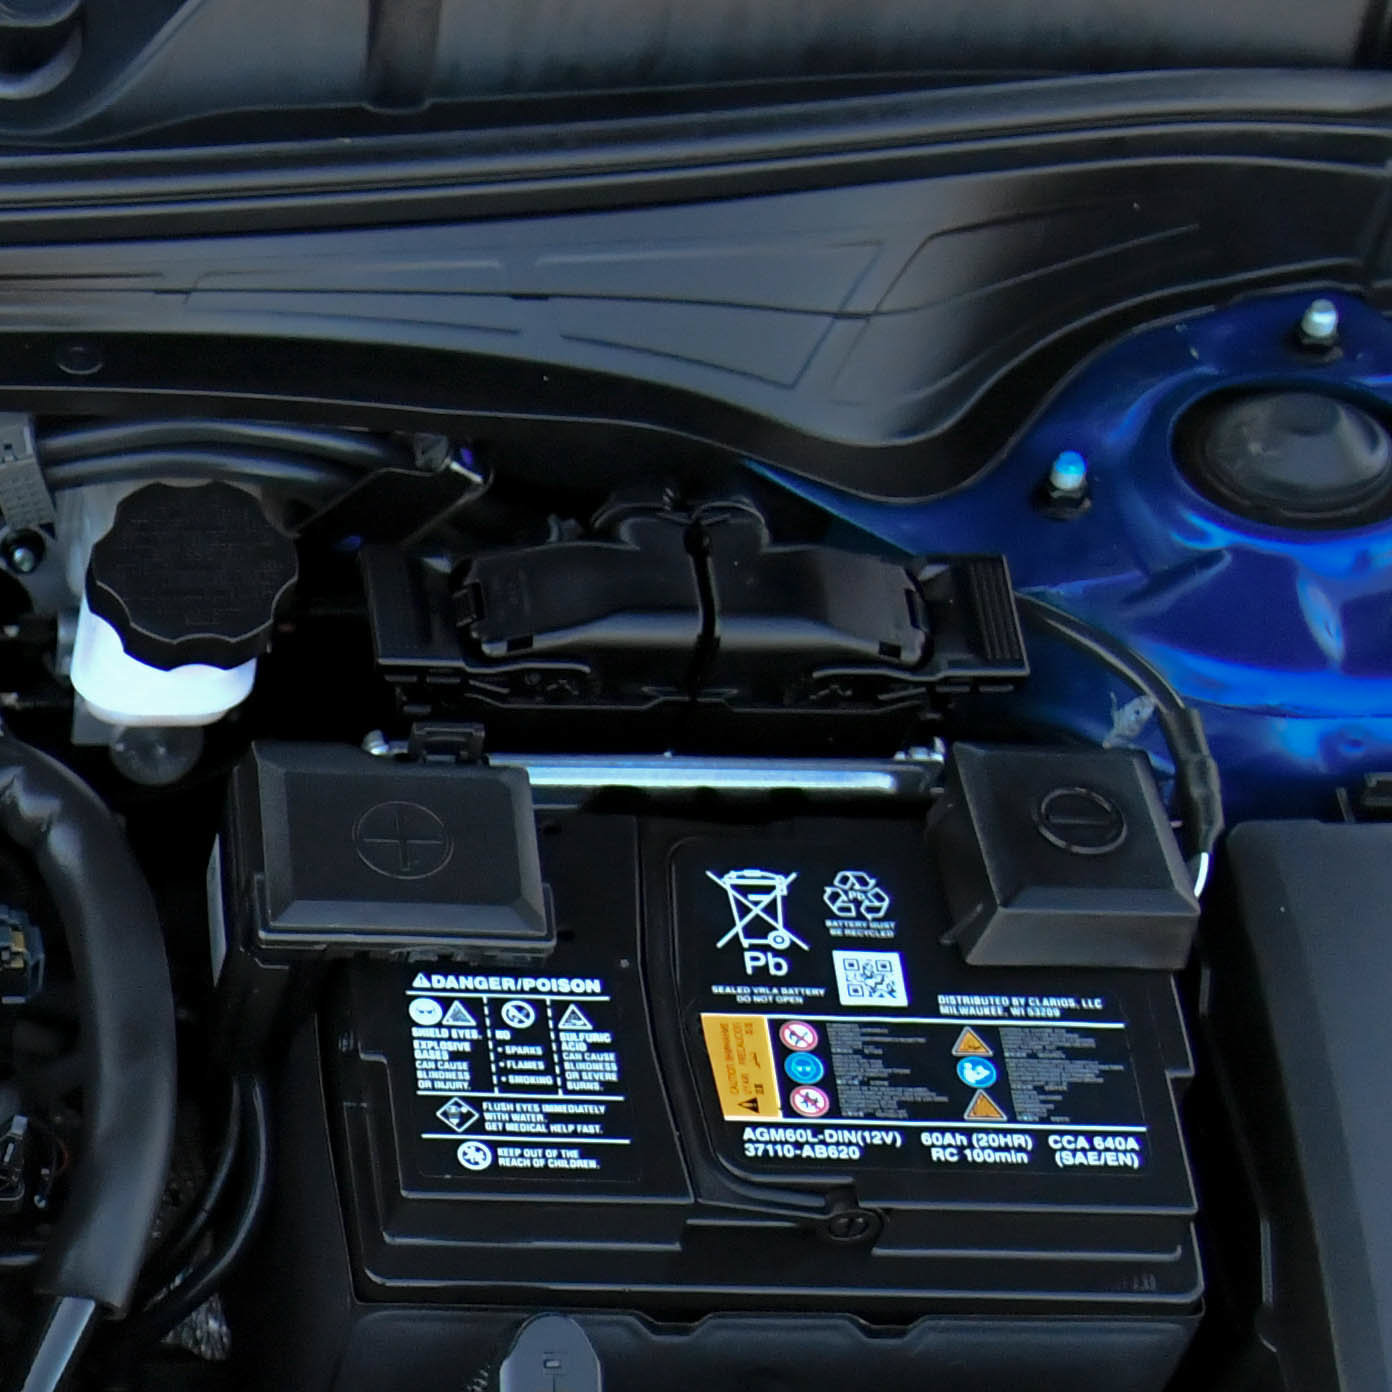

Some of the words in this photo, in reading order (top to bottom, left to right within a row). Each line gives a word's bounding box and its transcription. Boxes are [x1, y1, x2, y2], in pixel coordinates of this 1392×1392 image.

[825, 920, 867, 929] BATTERY
[869, 921, 895, 929] MUST
[830, 928, 843, 937] BE
[845, 929, 894, 938] RECYCLED
[744, 952, 788, 976] Pb
[432, 975, 601, 993] DANGER/POISON
[712, 985, 750, 994] SEALED
[752, 987, 779, 995] VRLA
[781, 988, 825, 997] BATTERY
[737, 995, 751, 1003] DO
[753, 995, 773, 1004] NOT
[776, 996, 803, 1004] OPEN
[938, 995, 1009, 1006] DISTRIBUTED
[1012, 997, 1025, 1007] BY
[1082, 999, 1102, 1009] LLC
[1010, 1007, 1025, 1017] WI
[412, 1027, 449, 1038] SHIELD
[496, 1030, 511, 1040] NO
[560, 1032, 611, 1043] SULFURIC
[413, 1040, 471, 1051] EXPLOSIVE
[505, 1046, 542, 1055] SPARKS
[562, 1042, 587, 1051] ACID
[415, 1050, 449, 1060] GASES
[584, 1053, 614, 1061] CAUSE
[416, 1061, 435, 1069] CAN
[437, 1061, 468, 1070] CAUSE
[507, 1060, 544, 1070] FLAMES
[564, 1062, 617, 1071] BLINDNESS
[417, 1071, 470, 1080] BLINDNESS
[509, 1076, 553, 1085] SMOKING
[566, 1072, 580, 1080] OR
[582, 1072, 618, 1081] SEVERE
[418, 1080, 433, 1088] OR
[483, 1102, 514, 1112] FLUSH
[516, 1103, 540, 1112] EYES
[542, 1104, 605, 1114] IMMEDIATELY
[484, 1113, 509, 1121] WITH
[485, 1123, 503, 1131] GET
[505, 1123, 548, 1132] MEDICAL
[550, 1124, 574, 1133] HELP
[743, 1127, 902, 1148] AGM60L-DIN(12V)
[921, 1133, 967, 1147] 60Ah
[972, 1133, 1033, 1150] (20HR)
[1048, 1135, 1089, 1149] CCA
[1093, 1136, 1139, 1150] 640A
[498, 1148, 521, 1157] KEEP
[523, 1148, 543, 1158] OUT
[545, 1149, 559, 1158] OF
[561, 1149, 579, 1158] THE
[744, 1143, 860, 1160] 37110-AB620
[931, 1147, 958, 1162] RC
[964, 1149, 1028, 1164] 100min
[499, 1157, 531, 1167] REACH
[533, 1158, 546, 1167] OF
[1055, 1151, 1138, 1169] (SAE/EN)
